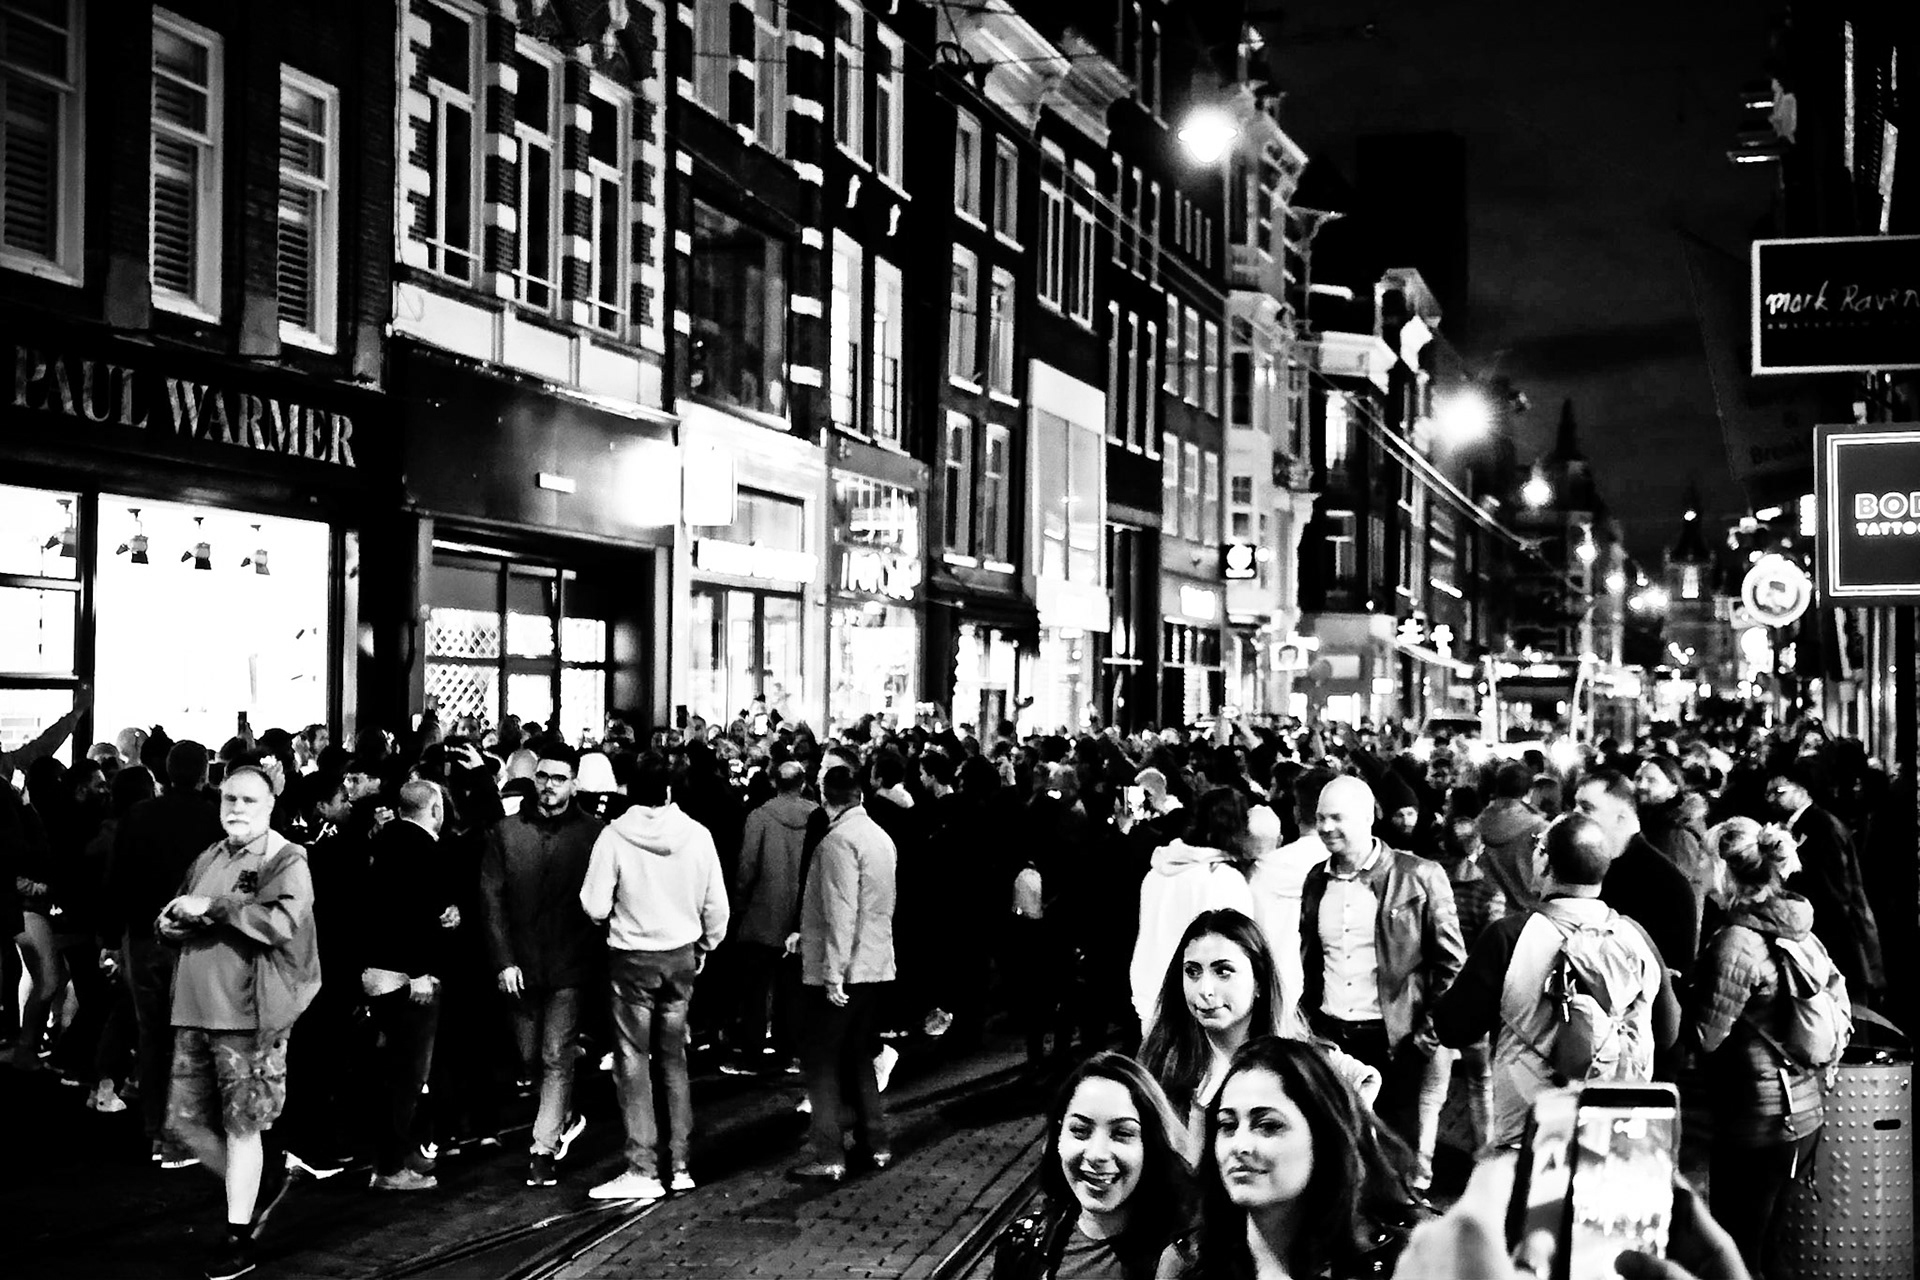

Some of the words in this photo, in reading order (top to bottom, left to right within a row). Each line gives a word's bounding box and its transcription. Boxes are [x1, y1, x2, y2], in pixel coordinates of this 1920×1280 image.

[11, 345, 149, 429] PAUL
[165, 376, 357, 468] WARMER
[1856, 521, 1920, 536] TATTO
